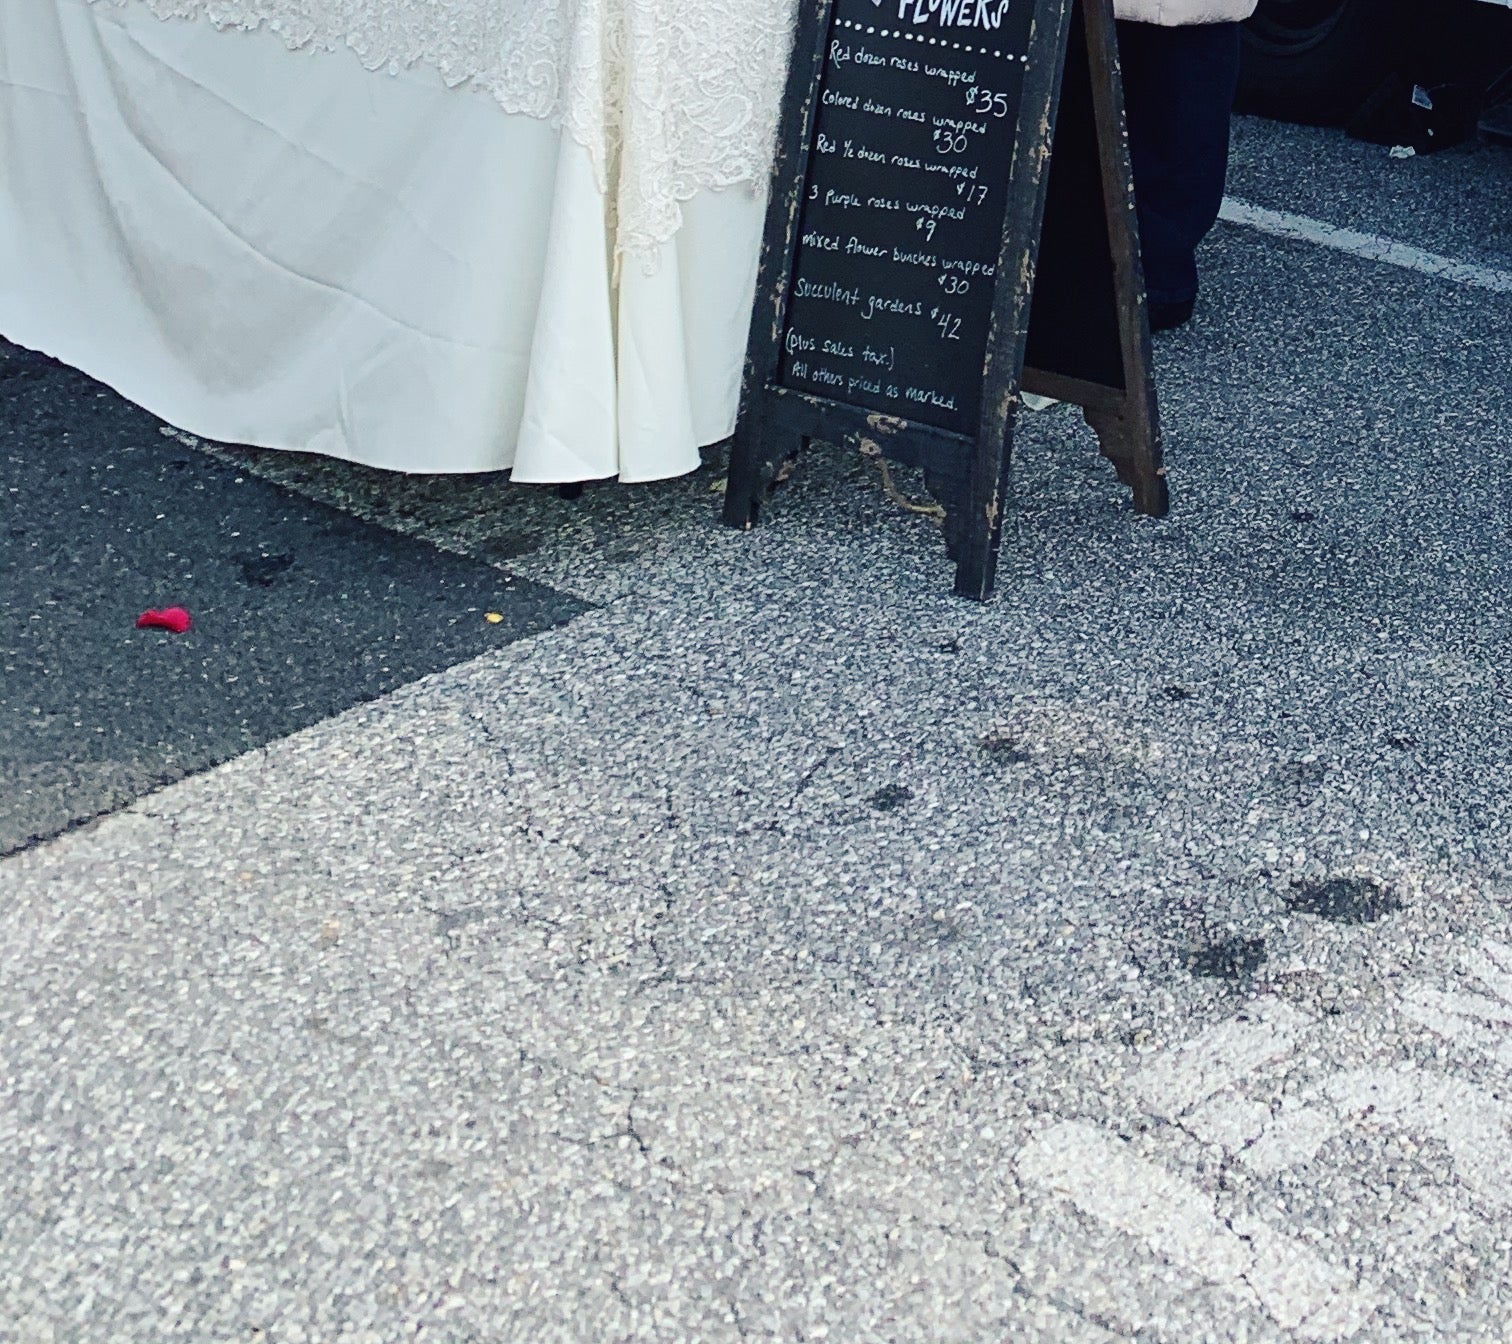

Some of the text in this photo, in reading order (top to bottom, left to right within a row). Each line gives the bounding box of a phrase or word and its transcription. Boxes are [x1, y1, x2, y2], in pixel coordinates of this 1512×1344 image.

[829, 39, 976, 86] Red dozen roses wrapped
[822, 89, 987, 134] Colored dozen roses wrapped
[966, 85, 1008, 118] $35
[816, 133, 836, 153] Red
[857, 146, 886, 164] dozen
[891, 156, 921, 169] roses
[925, 162, 979, 179] wrapped
[933, 128, 968, 154] $30
[808, 184, 819, 200] 3
[867, 197, 900, 210] roses
[906, 201, 966, 220] wrapped
[956, 181, 988, 206] $17
[916, 216, 937, 242] $9
[845, 236, 888, 257] flower
[892, 246, 937, 268] bunches
[941, 259, 996, 277] wrapped
[937, 273, 970, 295] $30
[794, 277, 962, 340] Succulent gardens $42
[821, 339, 854, 358] sales
[862, 346, 895, 372] tax.)
[792, 362, 808, 379] All
[812, 368, 844, 387] others
[848, 375, 880, 394] priced
[885, 384, 899, 399] as
